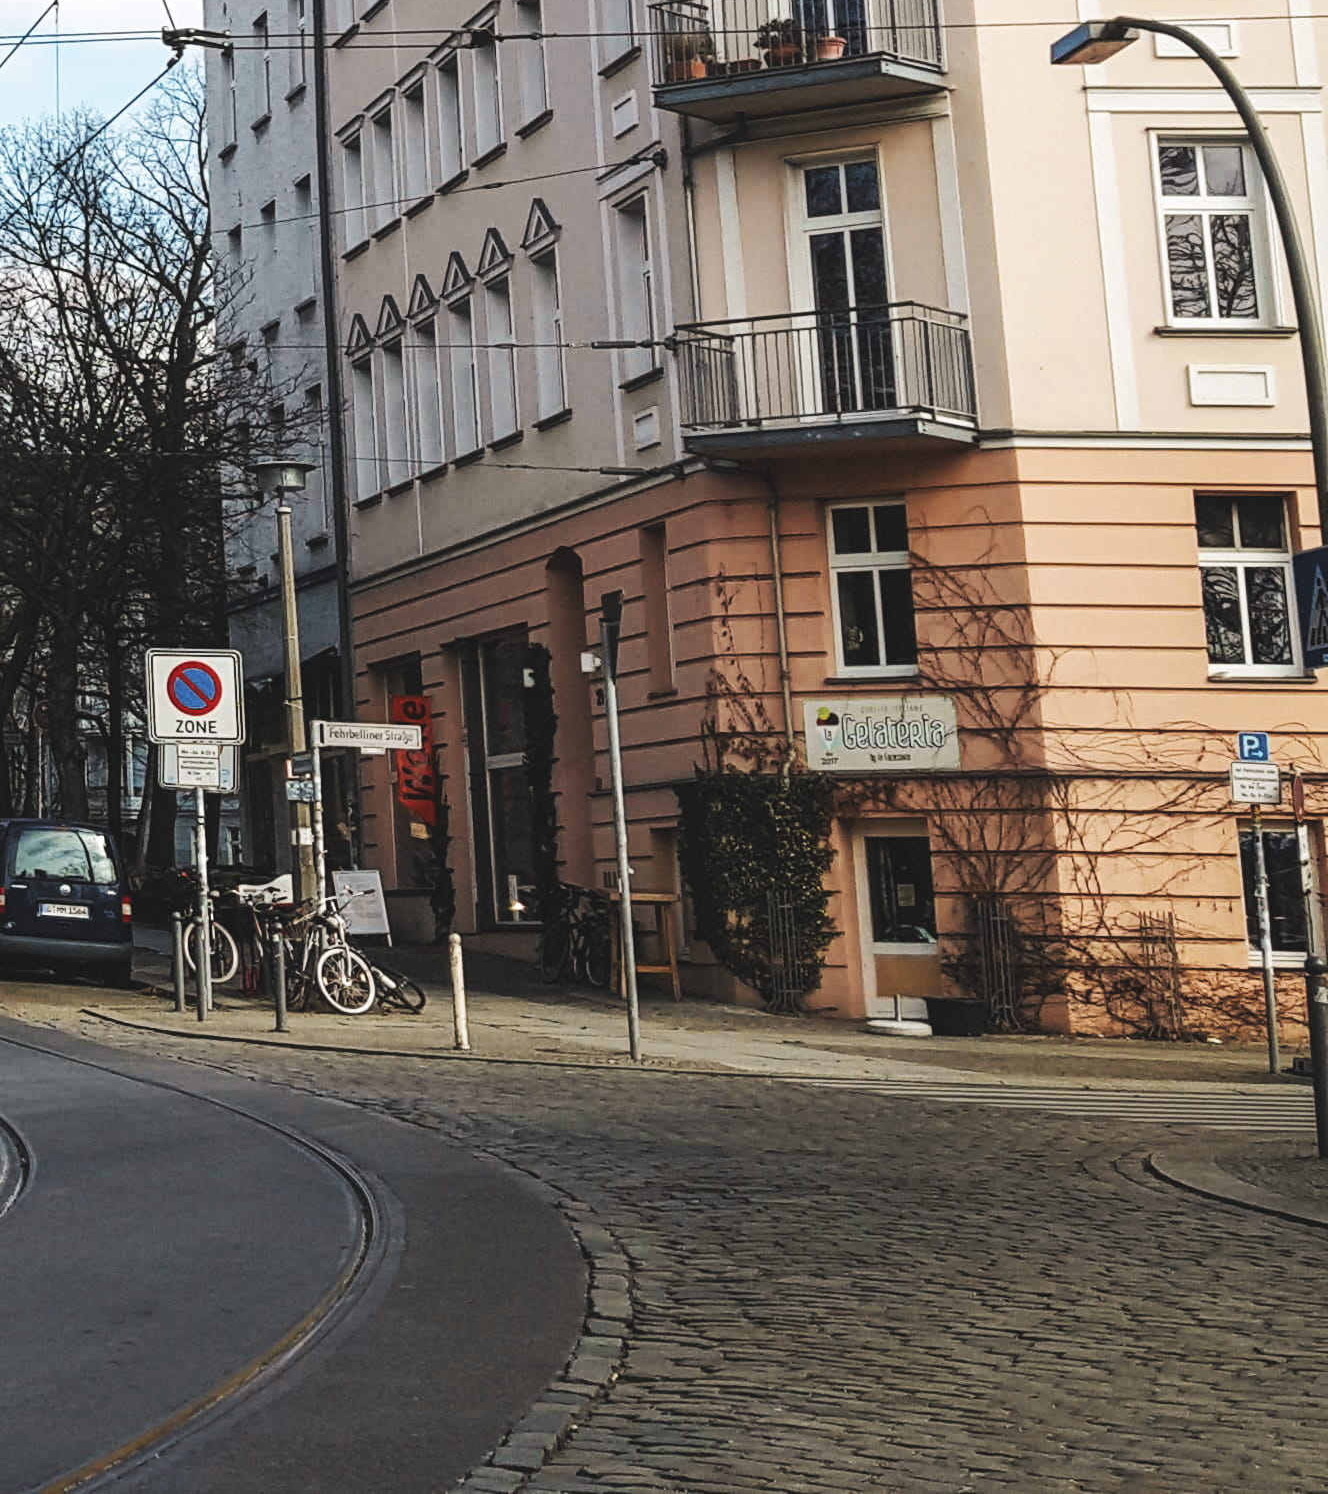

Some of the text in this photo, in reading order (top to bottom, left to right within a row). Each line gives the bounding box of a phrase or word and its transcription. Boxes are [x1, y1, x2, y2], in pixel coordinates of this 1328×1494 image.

[175, 719, 218, 734] ZONE
[328, 727, 414, 745] Fehrbelliner Straße
[1242, 735, 1260, 758] P
